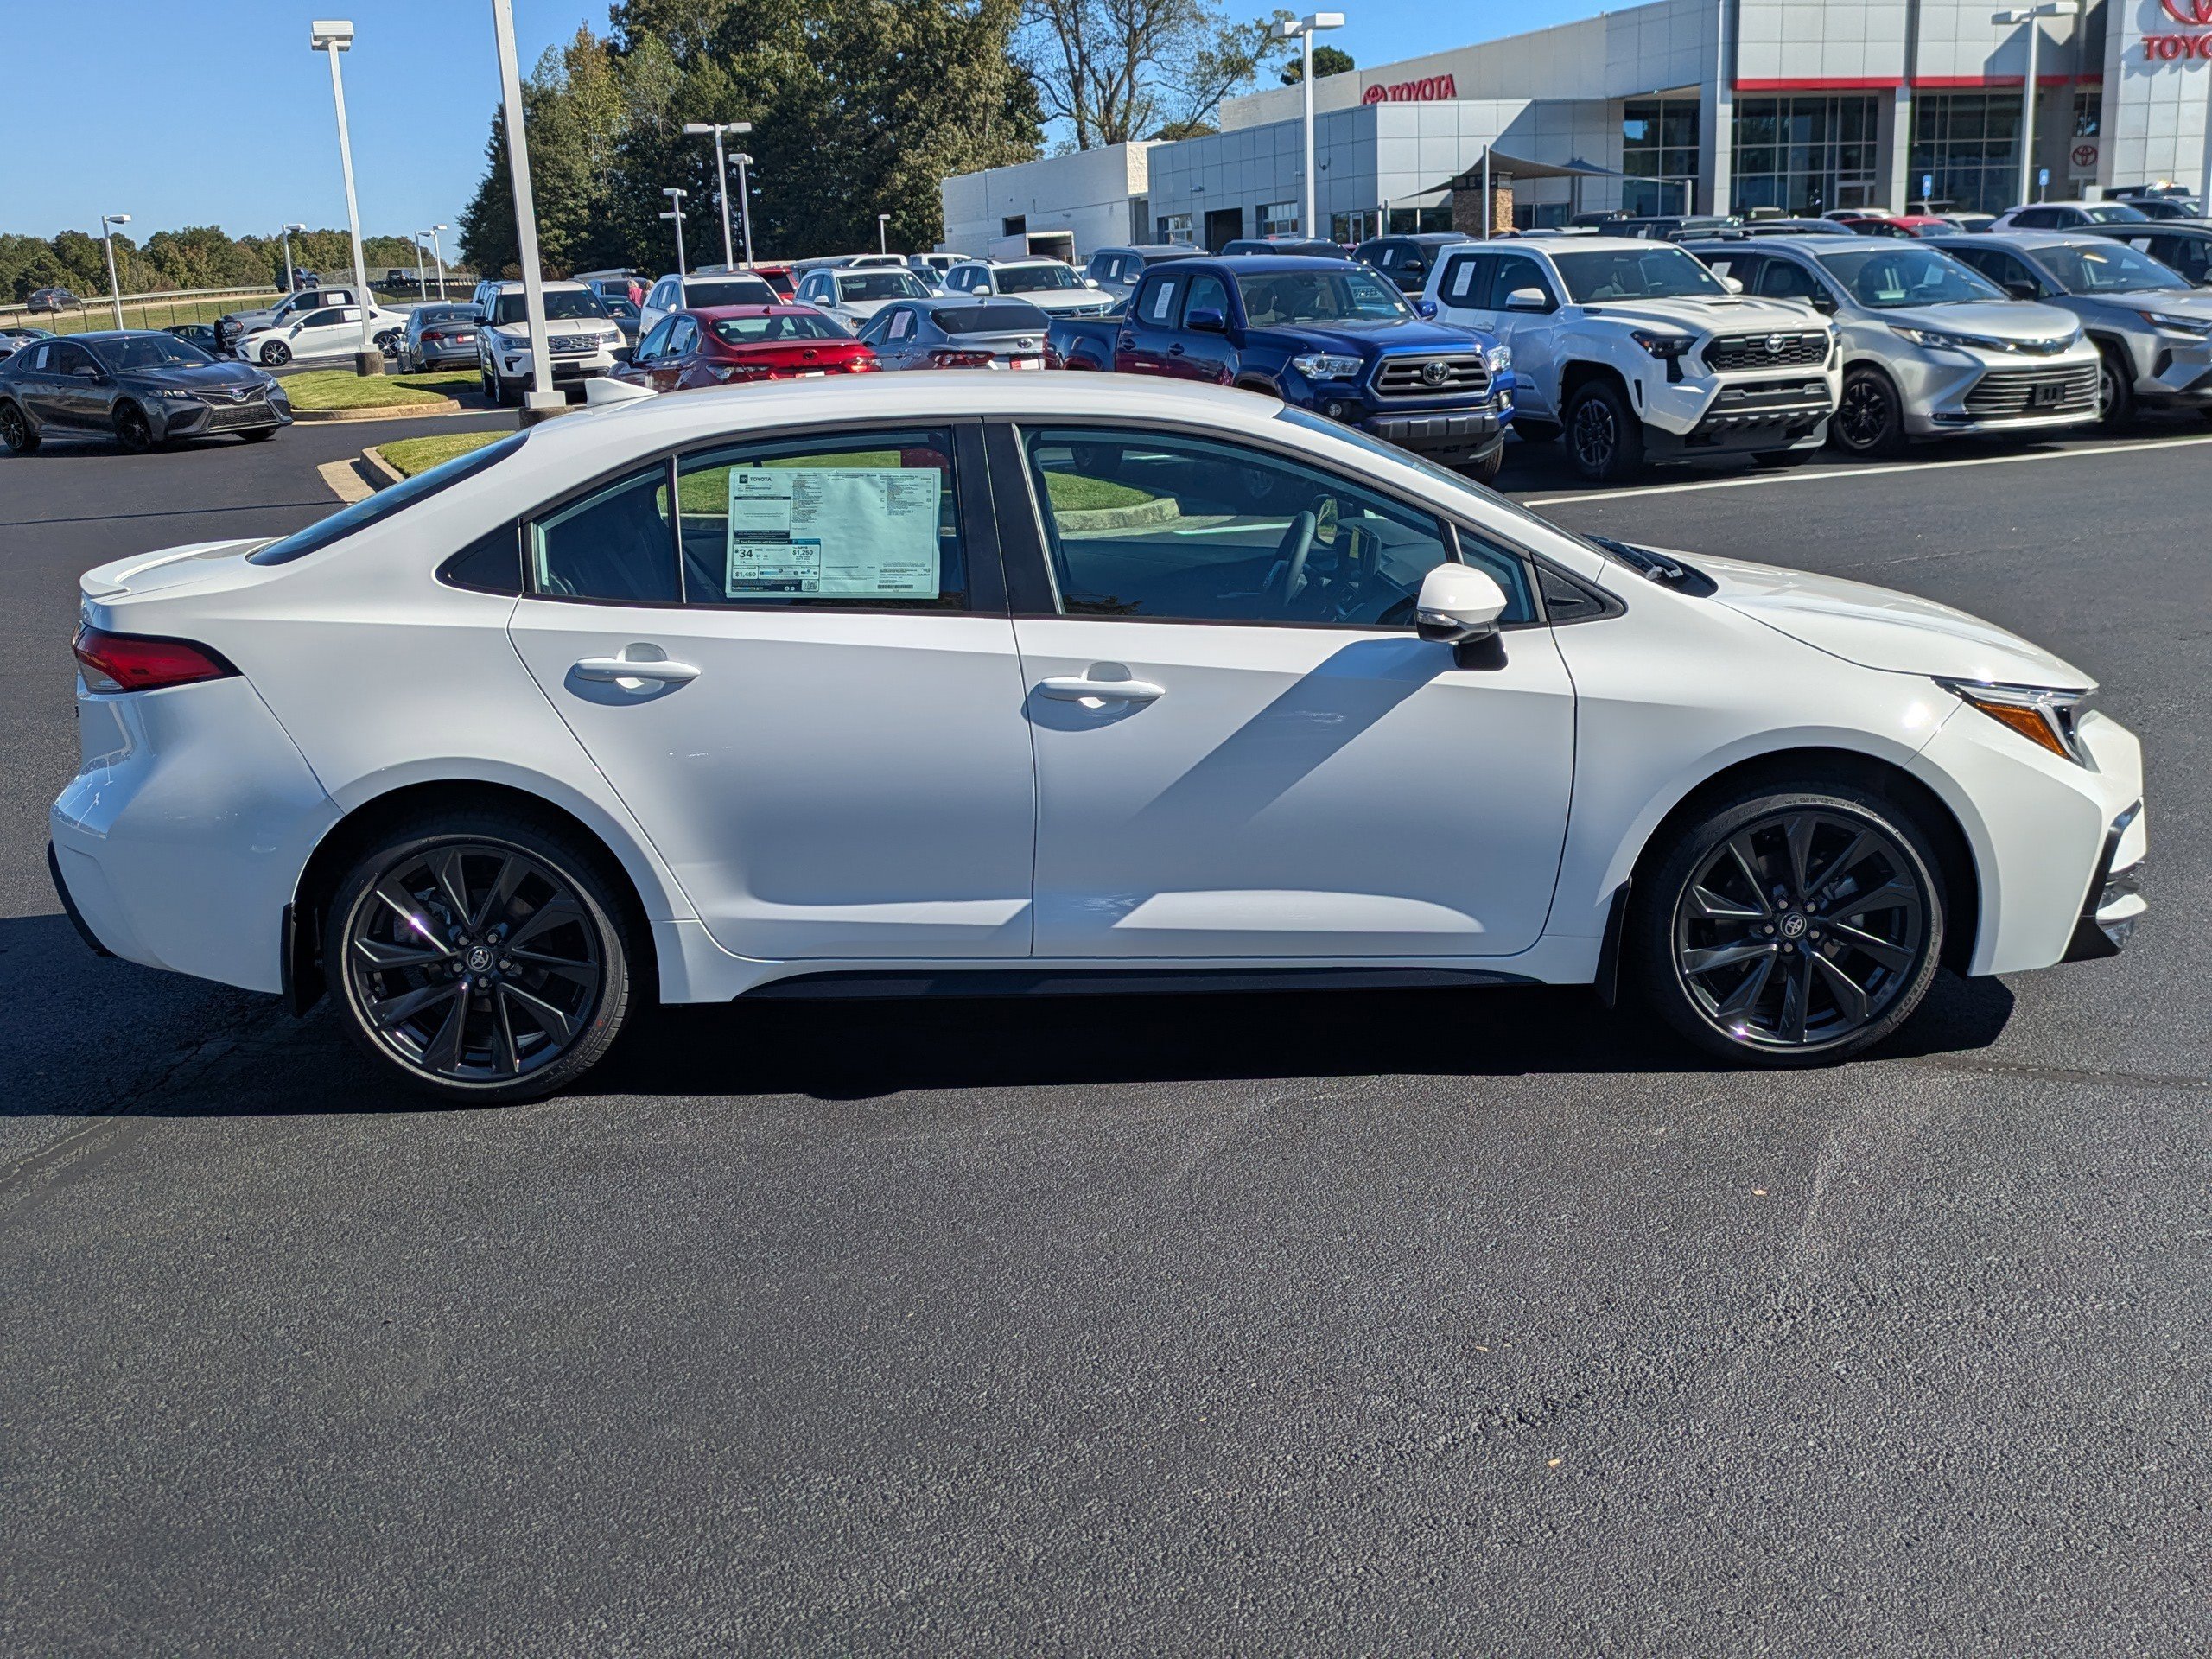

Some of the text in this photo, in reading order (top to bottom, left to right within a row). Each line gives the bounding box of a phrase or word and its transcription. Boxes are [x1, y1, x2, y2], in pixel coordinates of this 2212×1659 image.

[2141, 35, 2212, 60] TOYO
[1388, 73, 1457, 102] TOYOTA
[739, 549, 753, 558] 34
[1894, 954, 1935, 1018] DUNLOP
